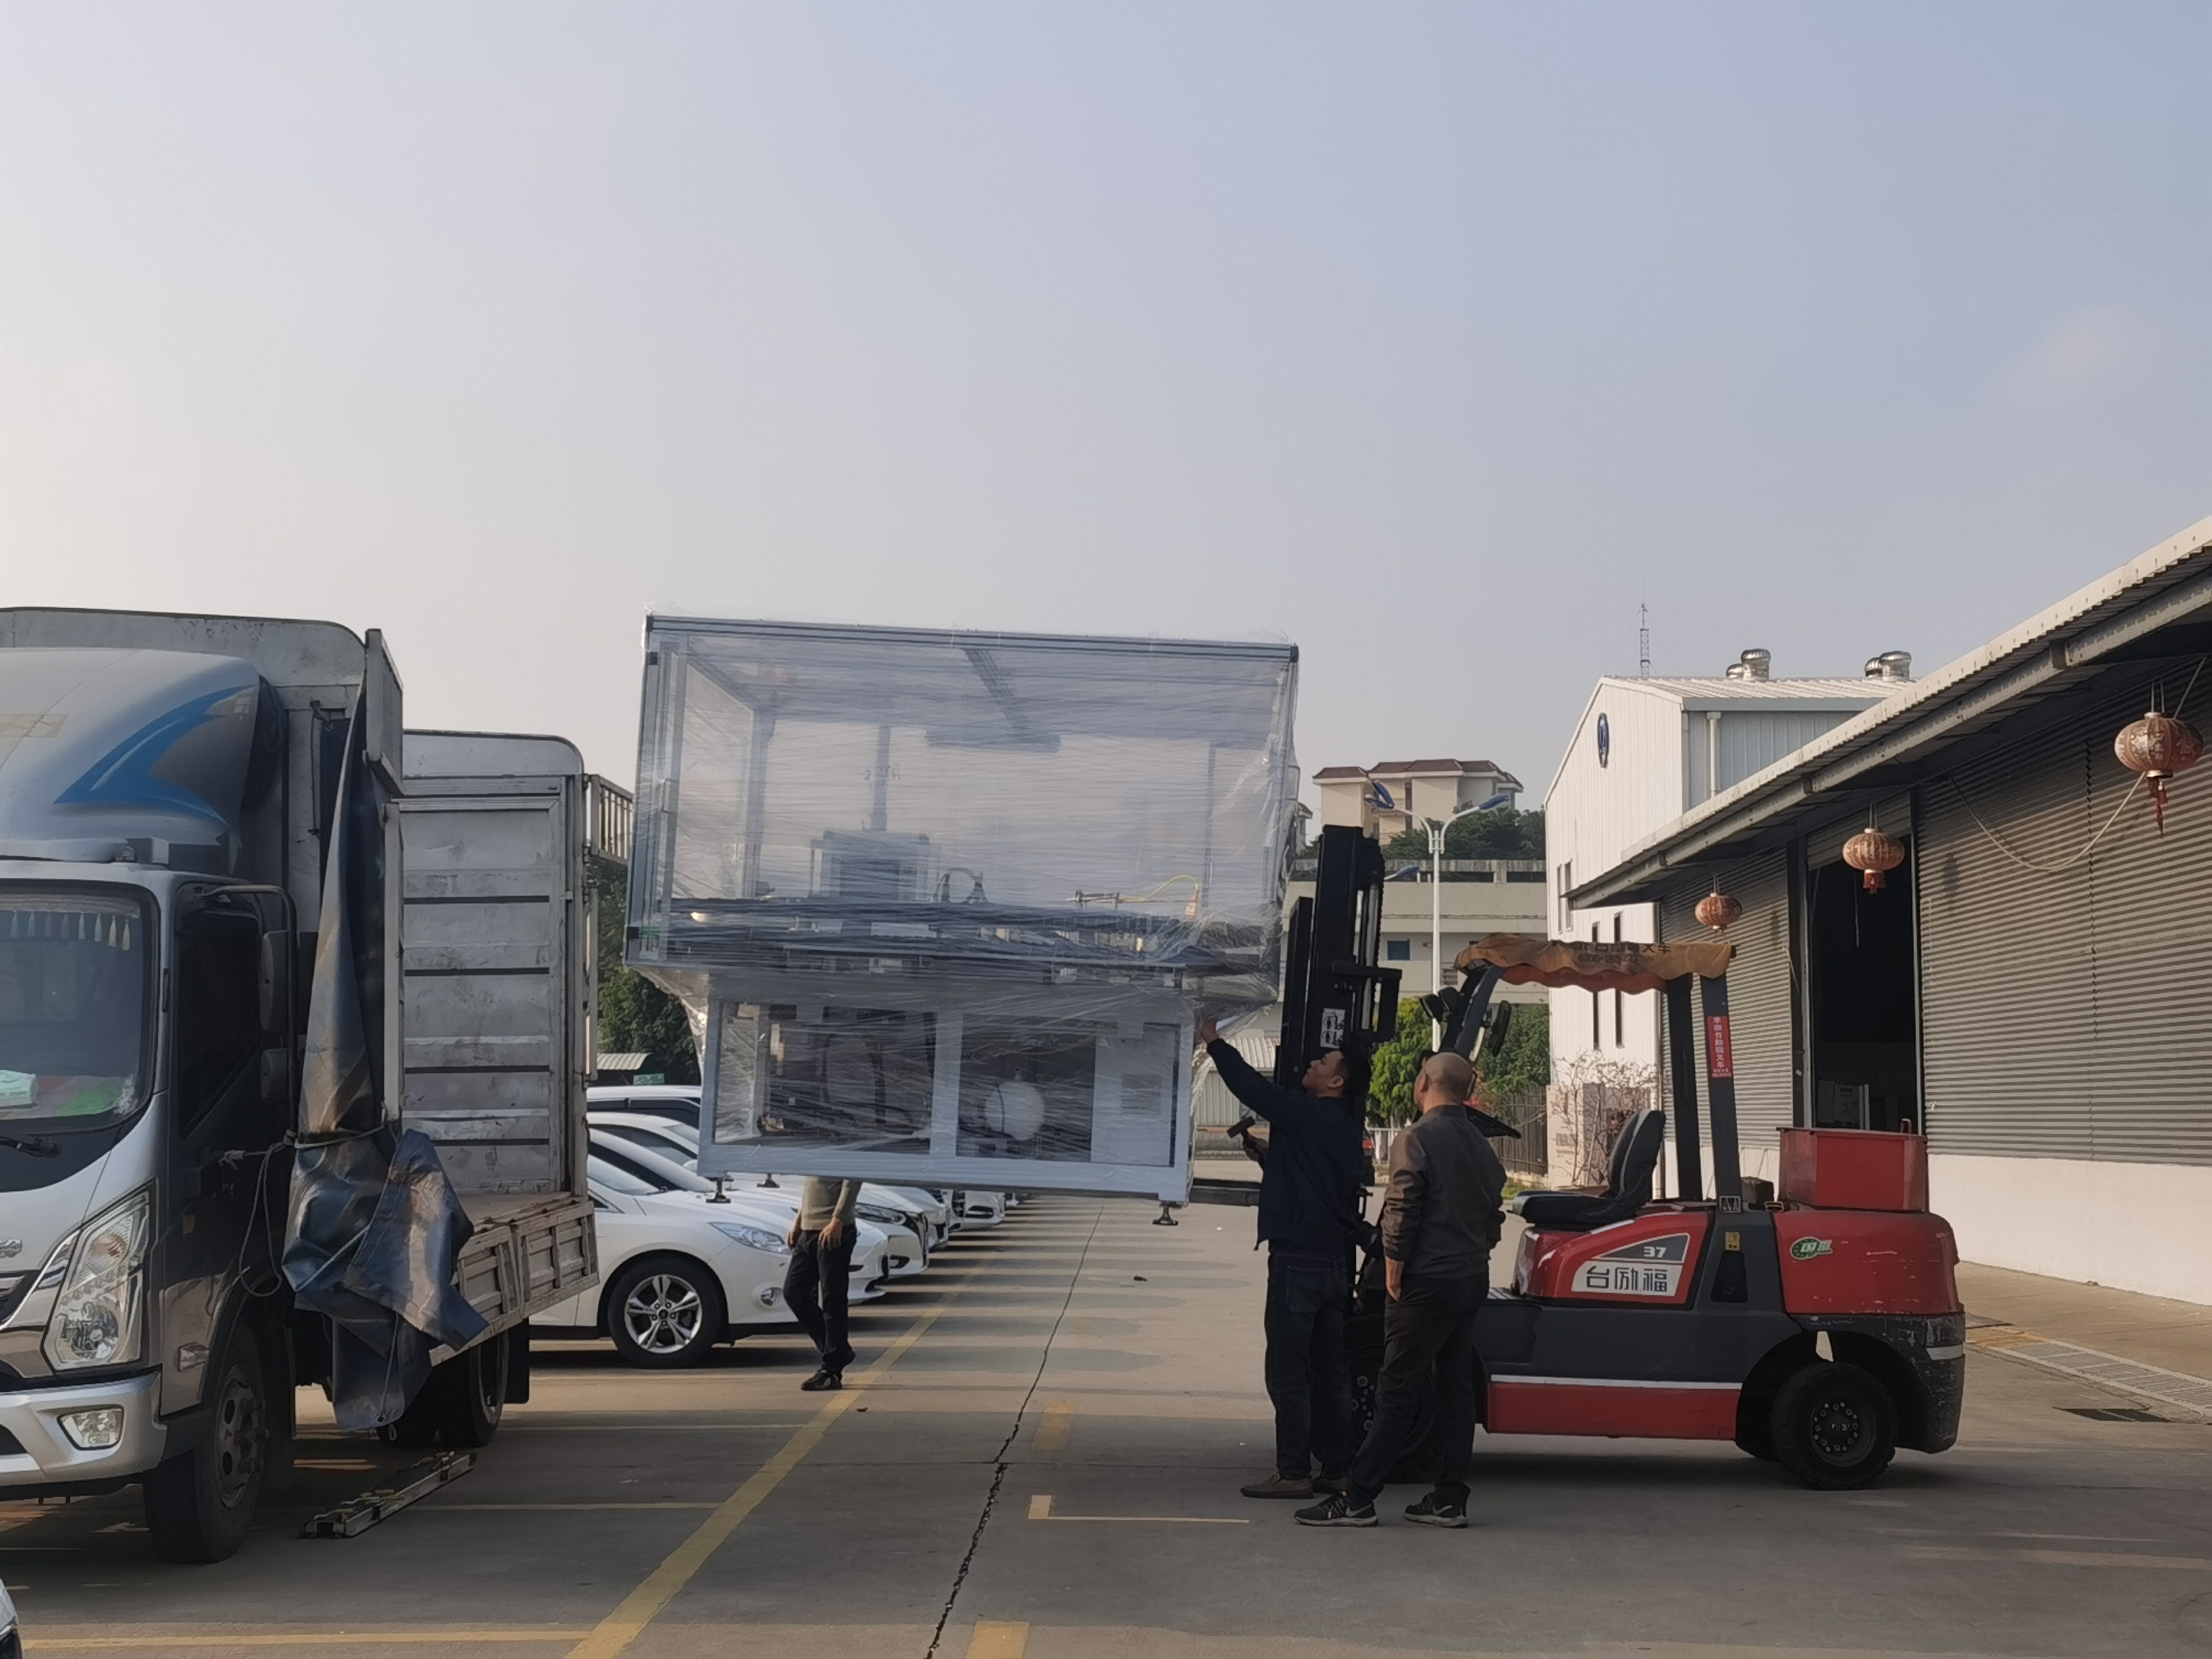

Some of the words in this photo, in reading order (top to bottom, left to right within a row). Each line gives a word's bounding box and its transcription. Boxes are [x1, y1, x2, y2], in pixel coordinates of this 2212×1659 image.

[1643, 1246, 1667, 1258] 37
[1586, 1265, 1667, 1292] 台励福
